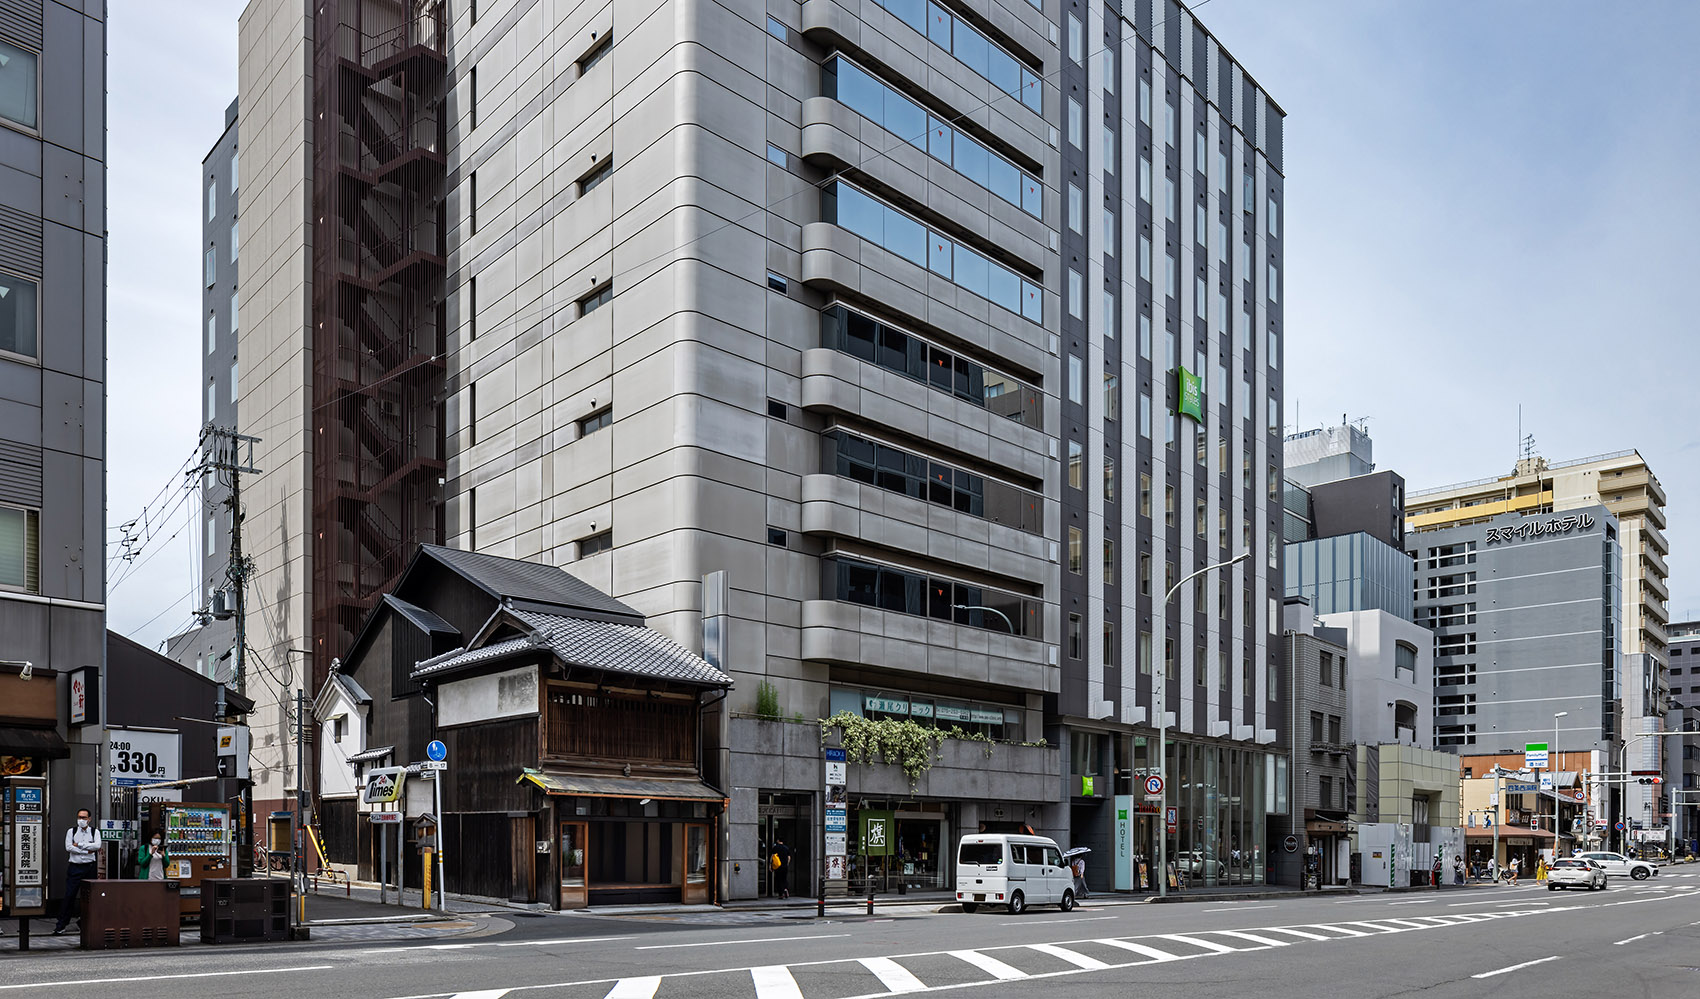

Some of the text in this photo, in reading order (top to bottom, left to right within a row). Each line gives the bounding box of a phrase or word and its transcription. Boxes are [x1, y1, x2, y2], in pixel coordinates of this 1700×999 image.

[1186, 378, 1198, 396] ibis
[1485, 513, 1595, 542] スマイルホテル
[110, 741, 131, 751] 24:00
[118, 751, 157, 774] 330
[158, 766, 166, 775] 円
[369, 782, 394, 799] Times
[869, 822, 885, 844] 旗
[21, 825, 31, 868] 四条西洞院
